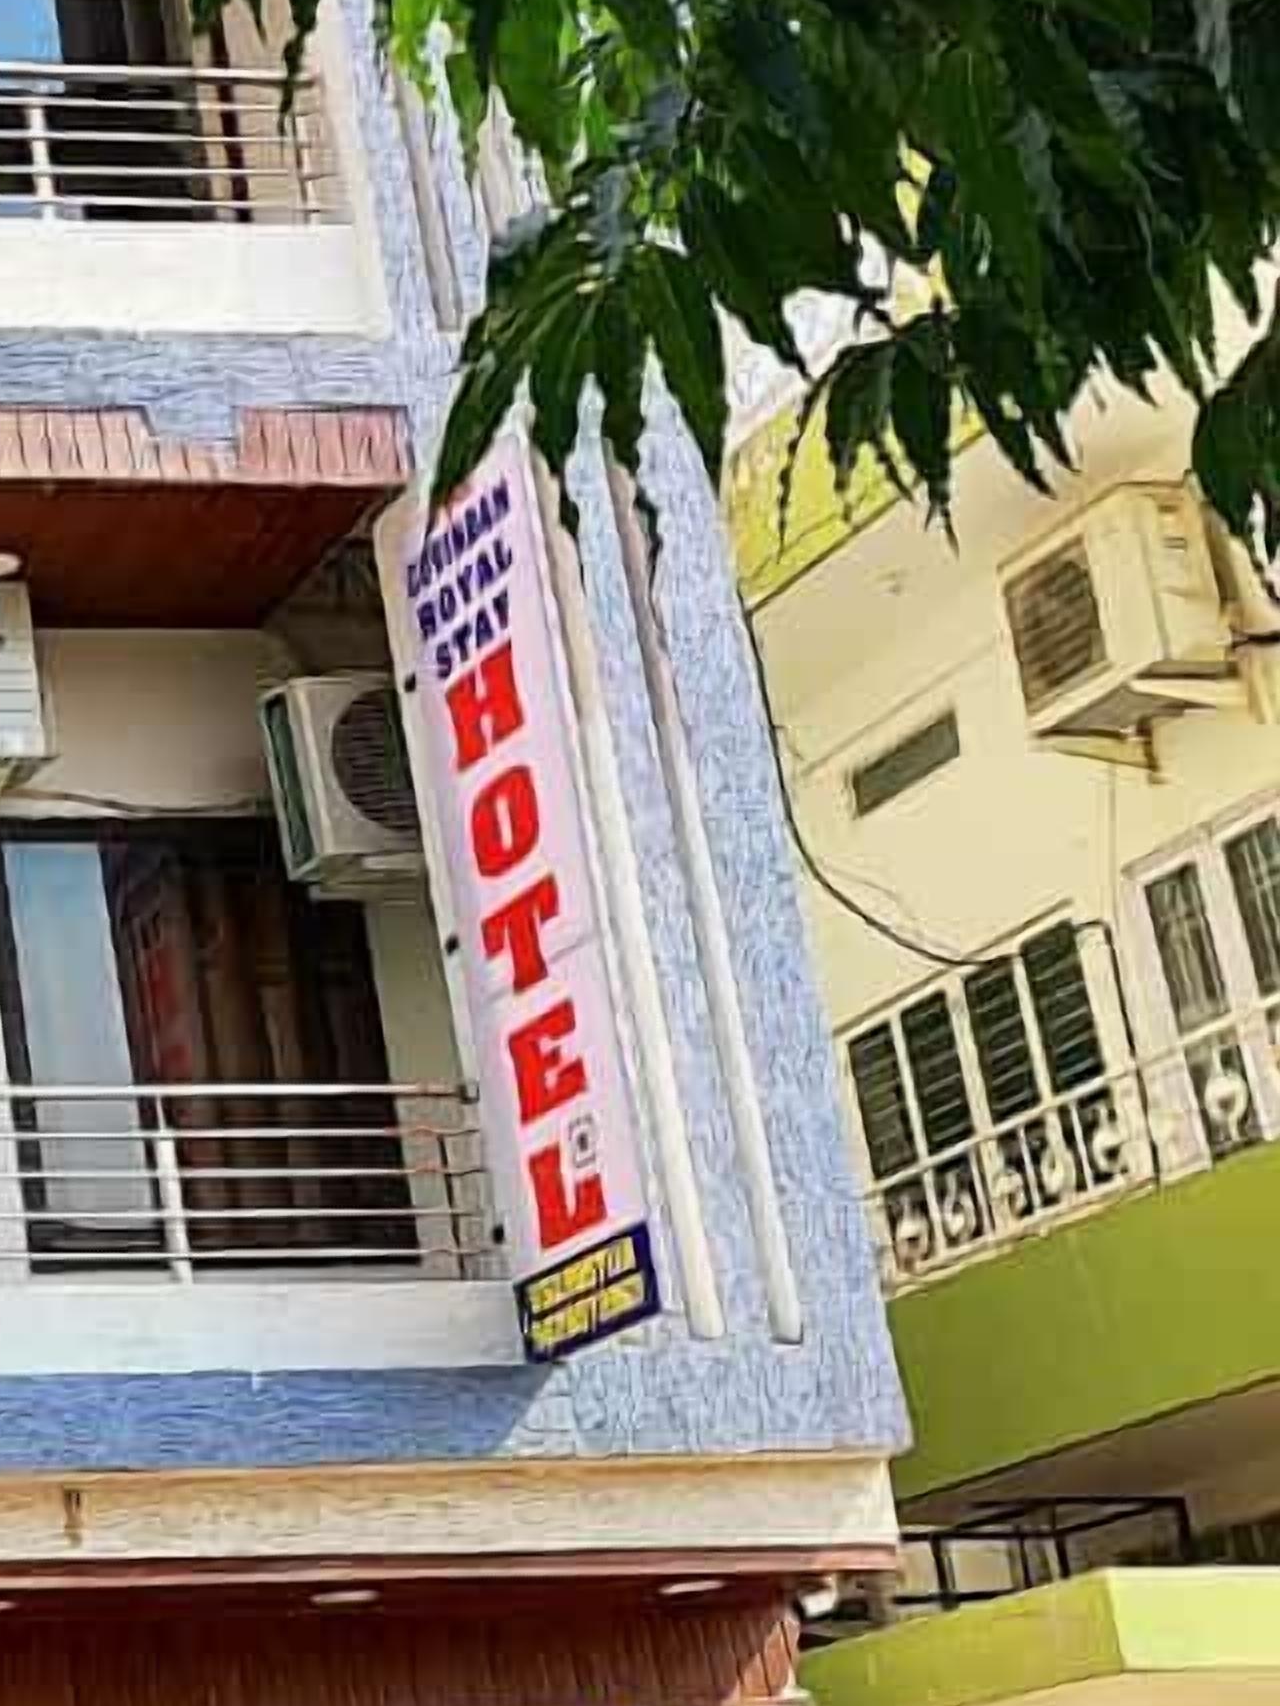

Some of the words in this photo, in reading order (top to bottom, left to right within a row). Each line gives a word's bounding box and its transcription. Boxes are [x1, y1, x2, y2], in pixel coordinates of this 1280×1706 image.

[417, 539, 513, 641] ROYAL
[436, 588, 508, 679] STAY
[444, 641, 608, 1250] HOTEL
